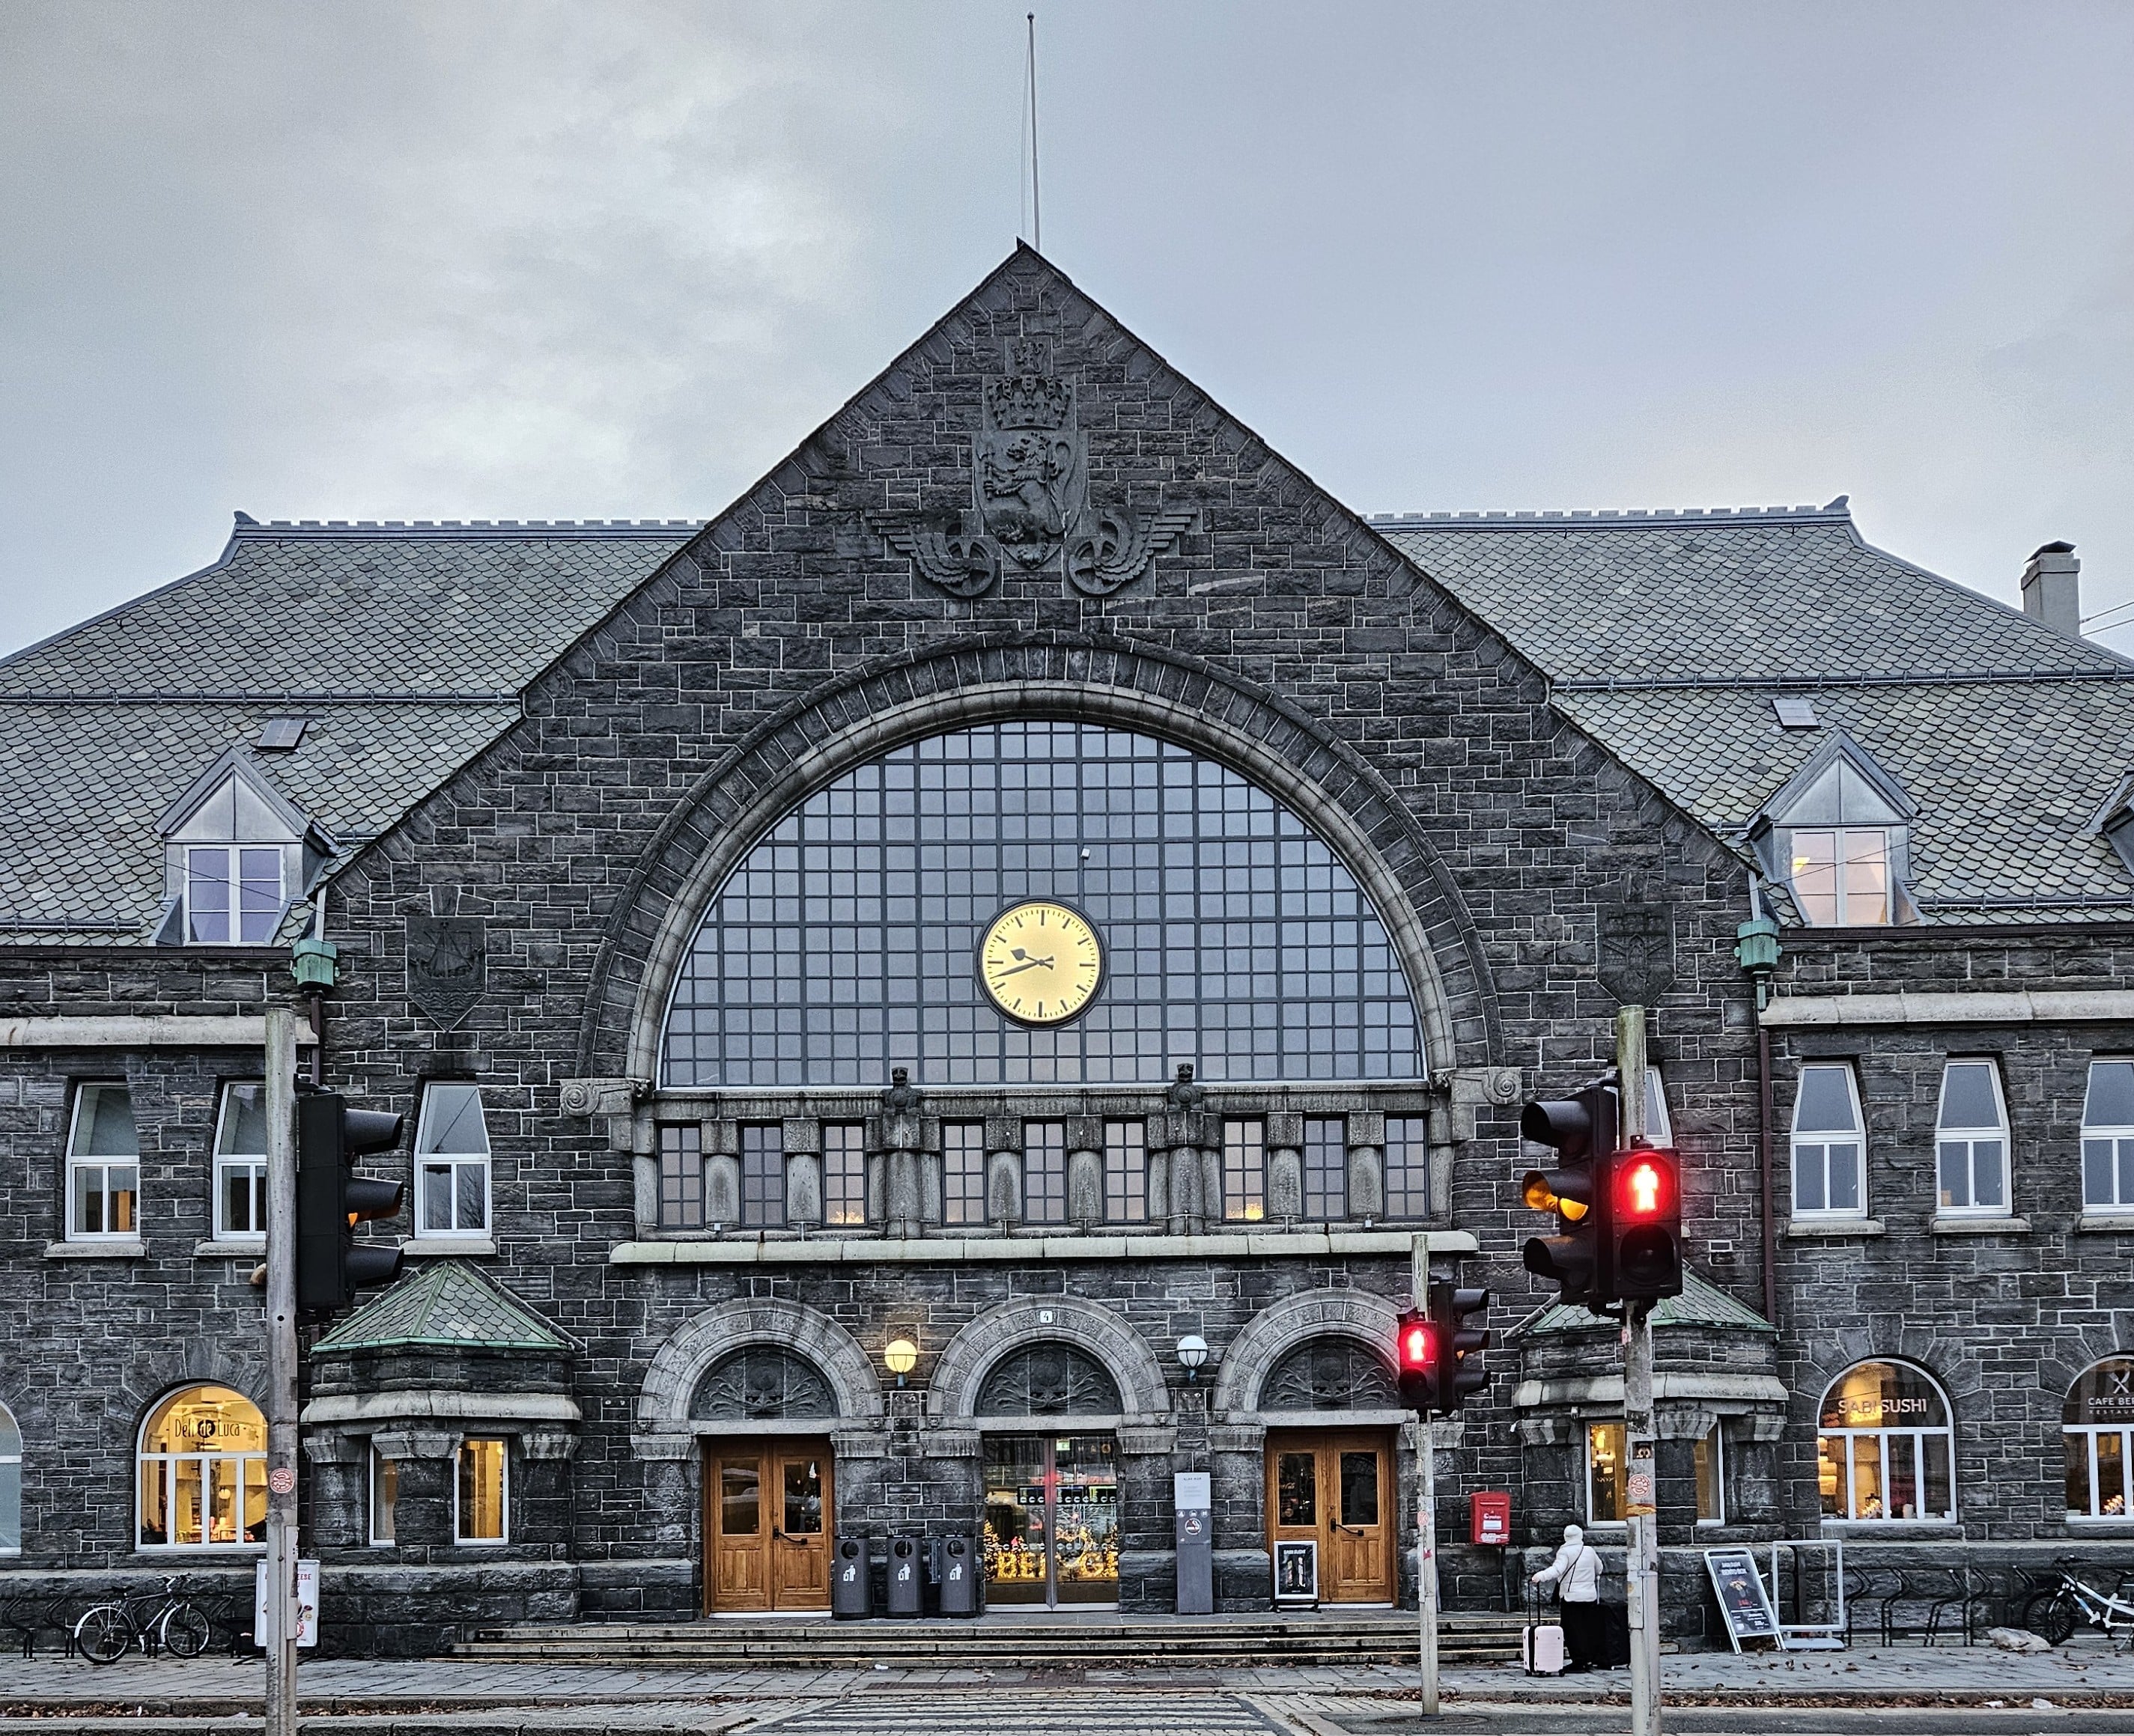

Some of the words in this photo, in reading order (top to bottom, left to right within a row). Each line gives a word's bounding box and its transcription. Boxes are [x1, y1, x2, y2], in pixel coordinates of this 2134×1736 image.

[1043, 1312, 1049, 1321] 4
[1837, 1399, 1877, 1414] SABI
[1880, 1398, 1927, 1413] SUSHI
[2088, 1397, 2115, 1406] CAFE
[199, 1419, 213, 1437] de
[217, 1419, 240, 1437] Luca
